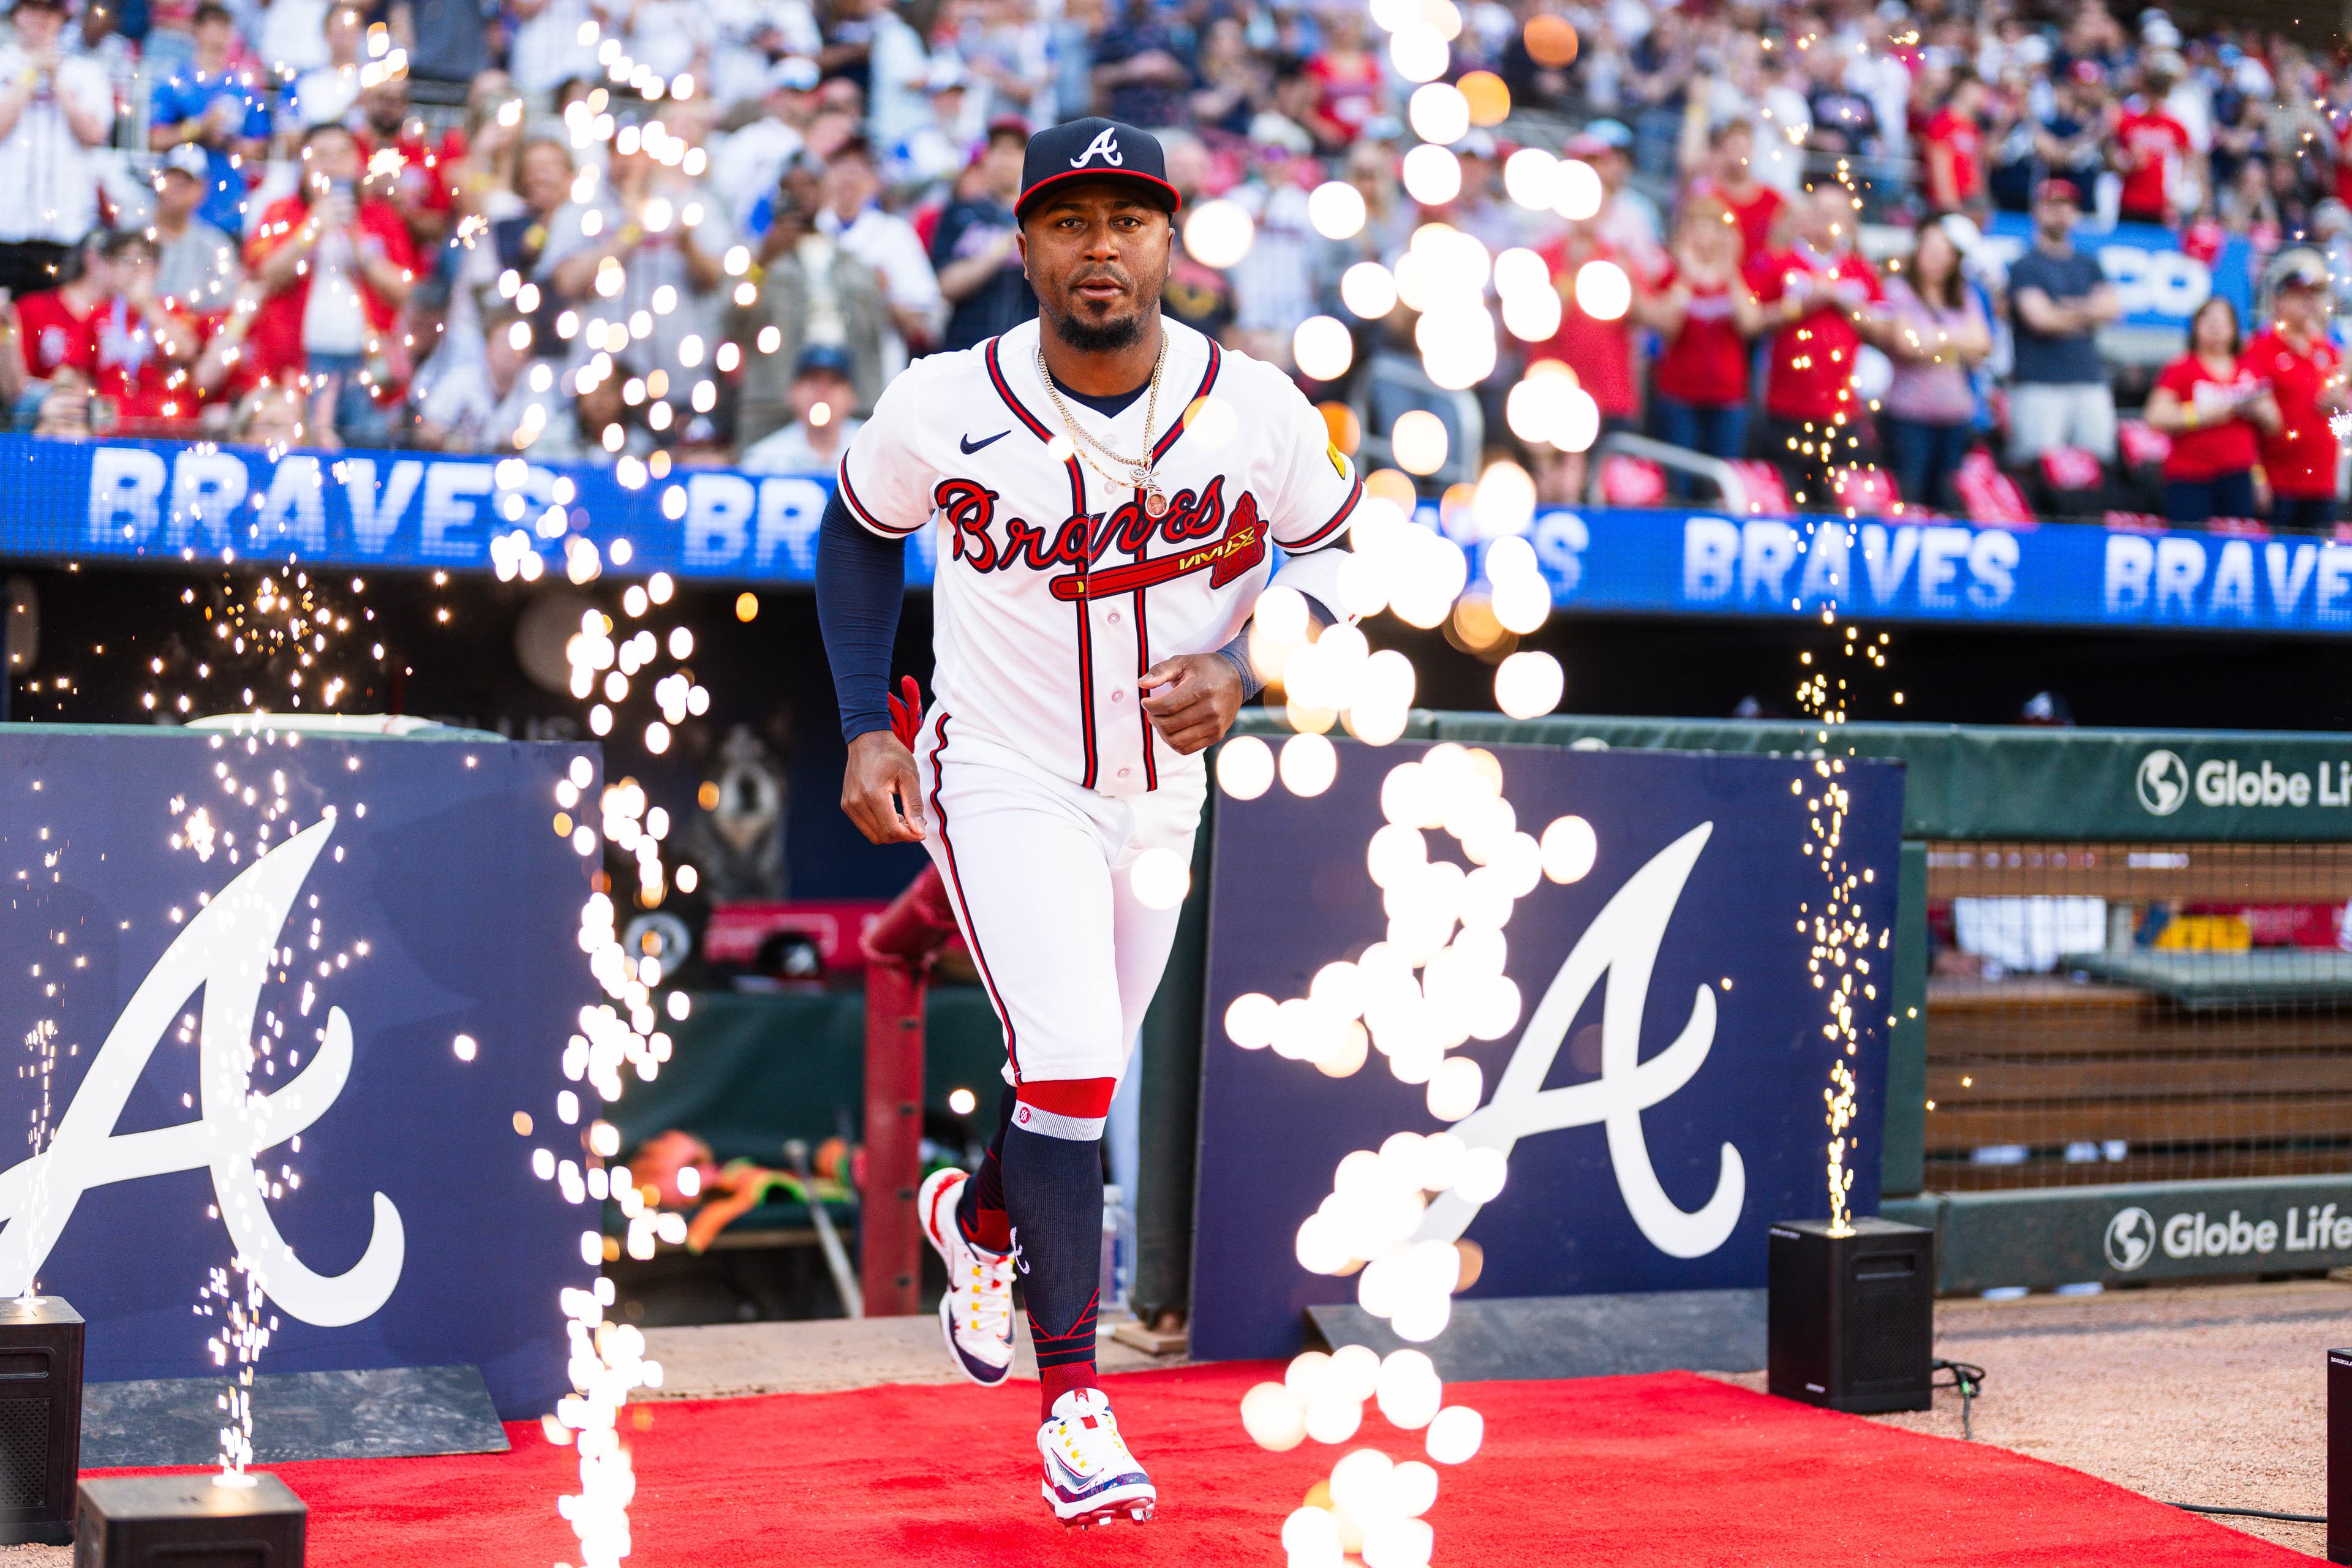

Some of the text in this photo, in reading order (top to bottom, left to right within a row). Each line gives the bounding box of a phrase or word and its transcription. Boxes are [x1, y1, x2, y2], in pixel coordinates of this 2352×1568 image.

[1069, 127, 1123, 168] A
[89, 447, 565, 557] BRAVES
[933, 473, 1226, 574] Braves
[1684, 516, 2021, 609] BRAVES
[2195, 759, 2352, 808] Globe Li
[0, 816, 405, 1327] A
[1403, 820, 1746, 1259] A
[2162, 1202, 2352, 1259] Globe Life
